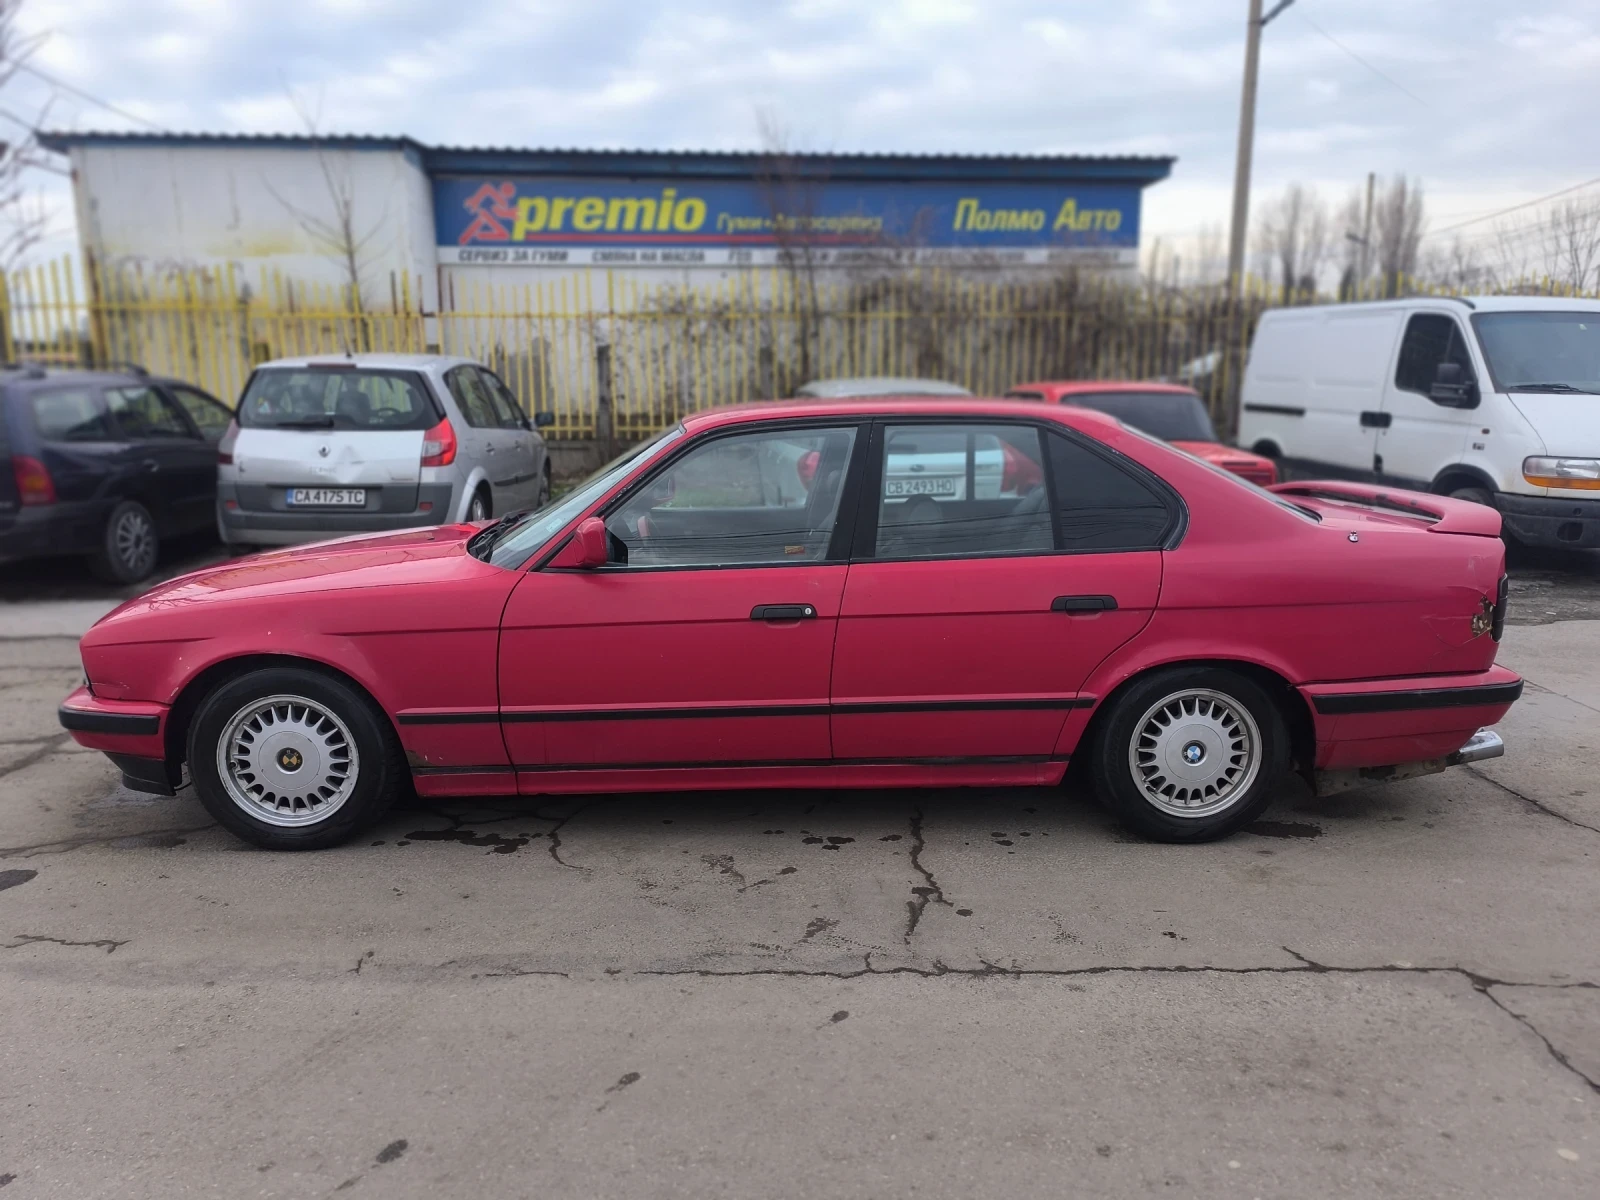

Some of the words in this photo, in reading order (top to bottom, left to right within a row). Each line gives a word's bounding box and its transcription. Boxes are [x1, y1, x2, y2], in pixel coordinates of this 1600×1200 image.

[512, 187, 707, 242] premio
[953, 198, 1046, 231] Полмо
[1053, 198, 1123, 231] Авто
[512, 249, 529, 262] ЗА
[531, 249, 568, 262] ГУМИ
[640, 250, 658, 263] НА
[887, 482, 904, 494] CB
[905, 481, 935, 494] 2493
[936, 479, 953, 492] HO
[295, 490, 311, 503] CA
[313, 490, 345, 503] 4175
[346, 490, 363, 503] TC
